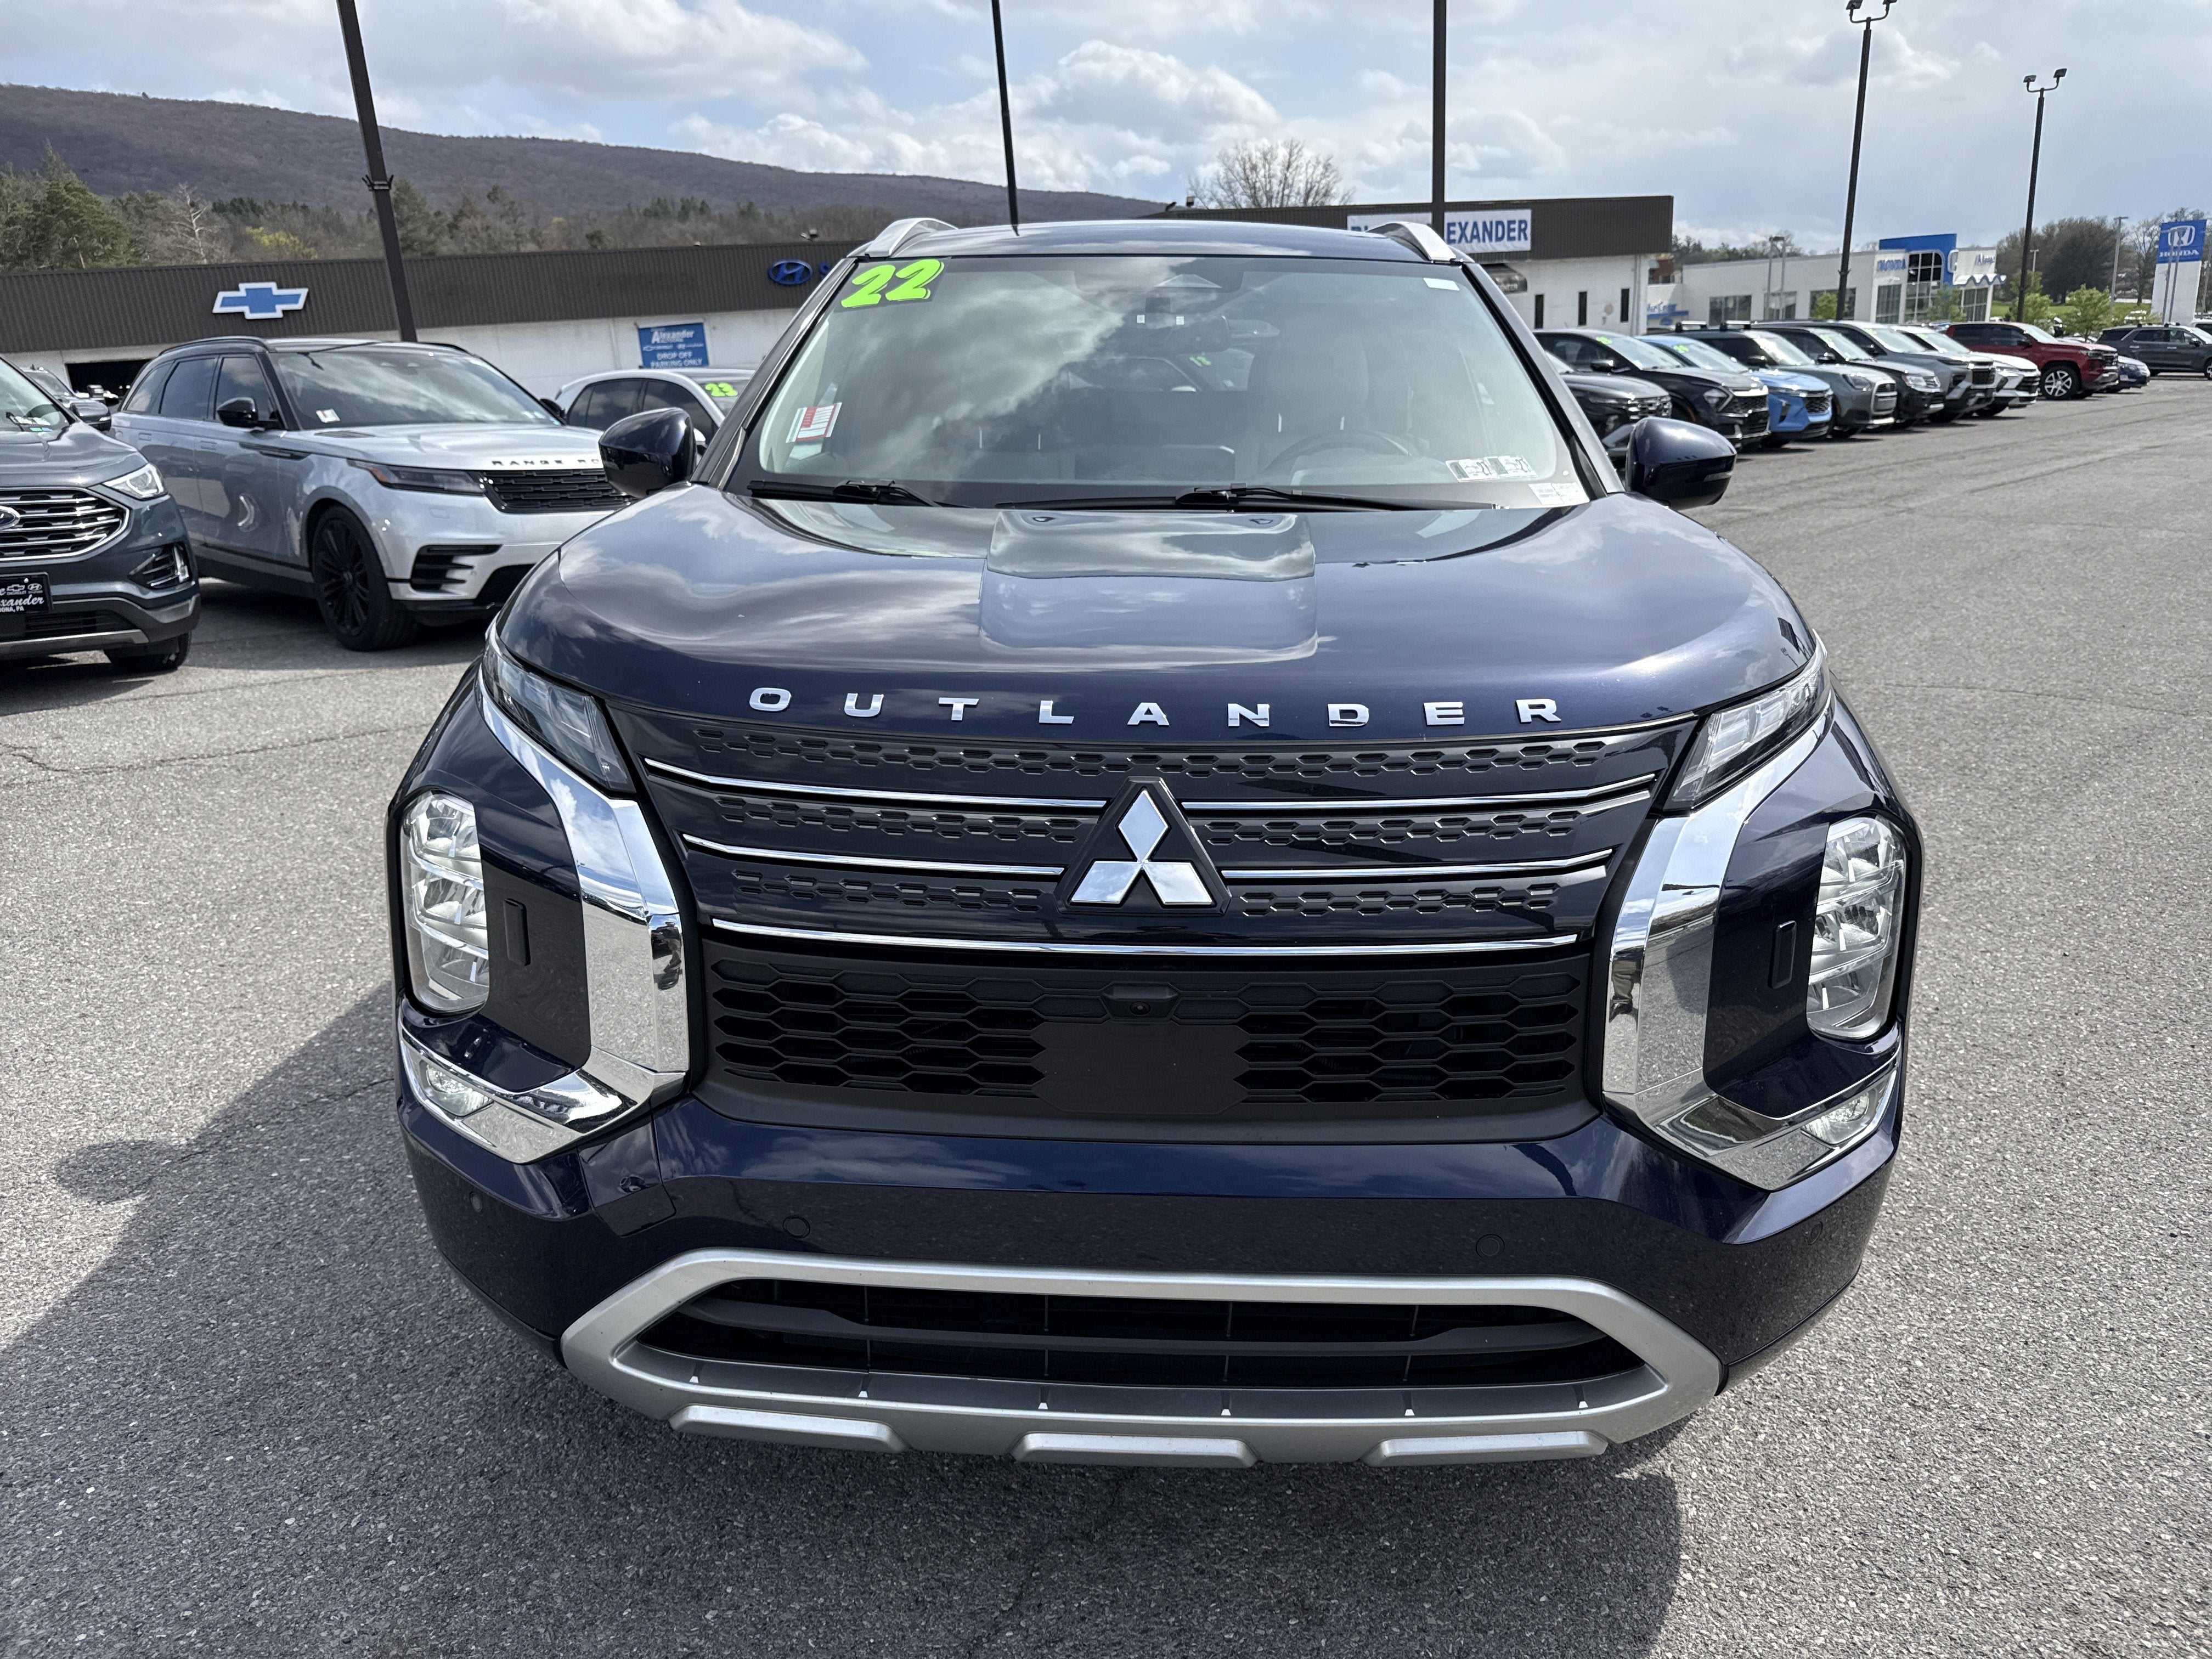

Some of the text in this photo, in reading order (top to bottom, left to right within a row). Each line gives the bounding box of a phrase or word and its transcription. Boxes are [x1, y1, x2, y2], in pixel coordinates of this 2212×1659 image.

[1446, 219, 1528, 245] EXANDER
[2159, 249, 2200, 258] HONDA
[841, 259, 945, 308] 22
[657, 351, 693, 360] DROP OFF
[650, 358, 702, 369] PARKING ONLY
[704, 381, 738, 397] 23
[0, 594, 44, 607] xander
[749, 687, 1562, 727] OUTLANDER
